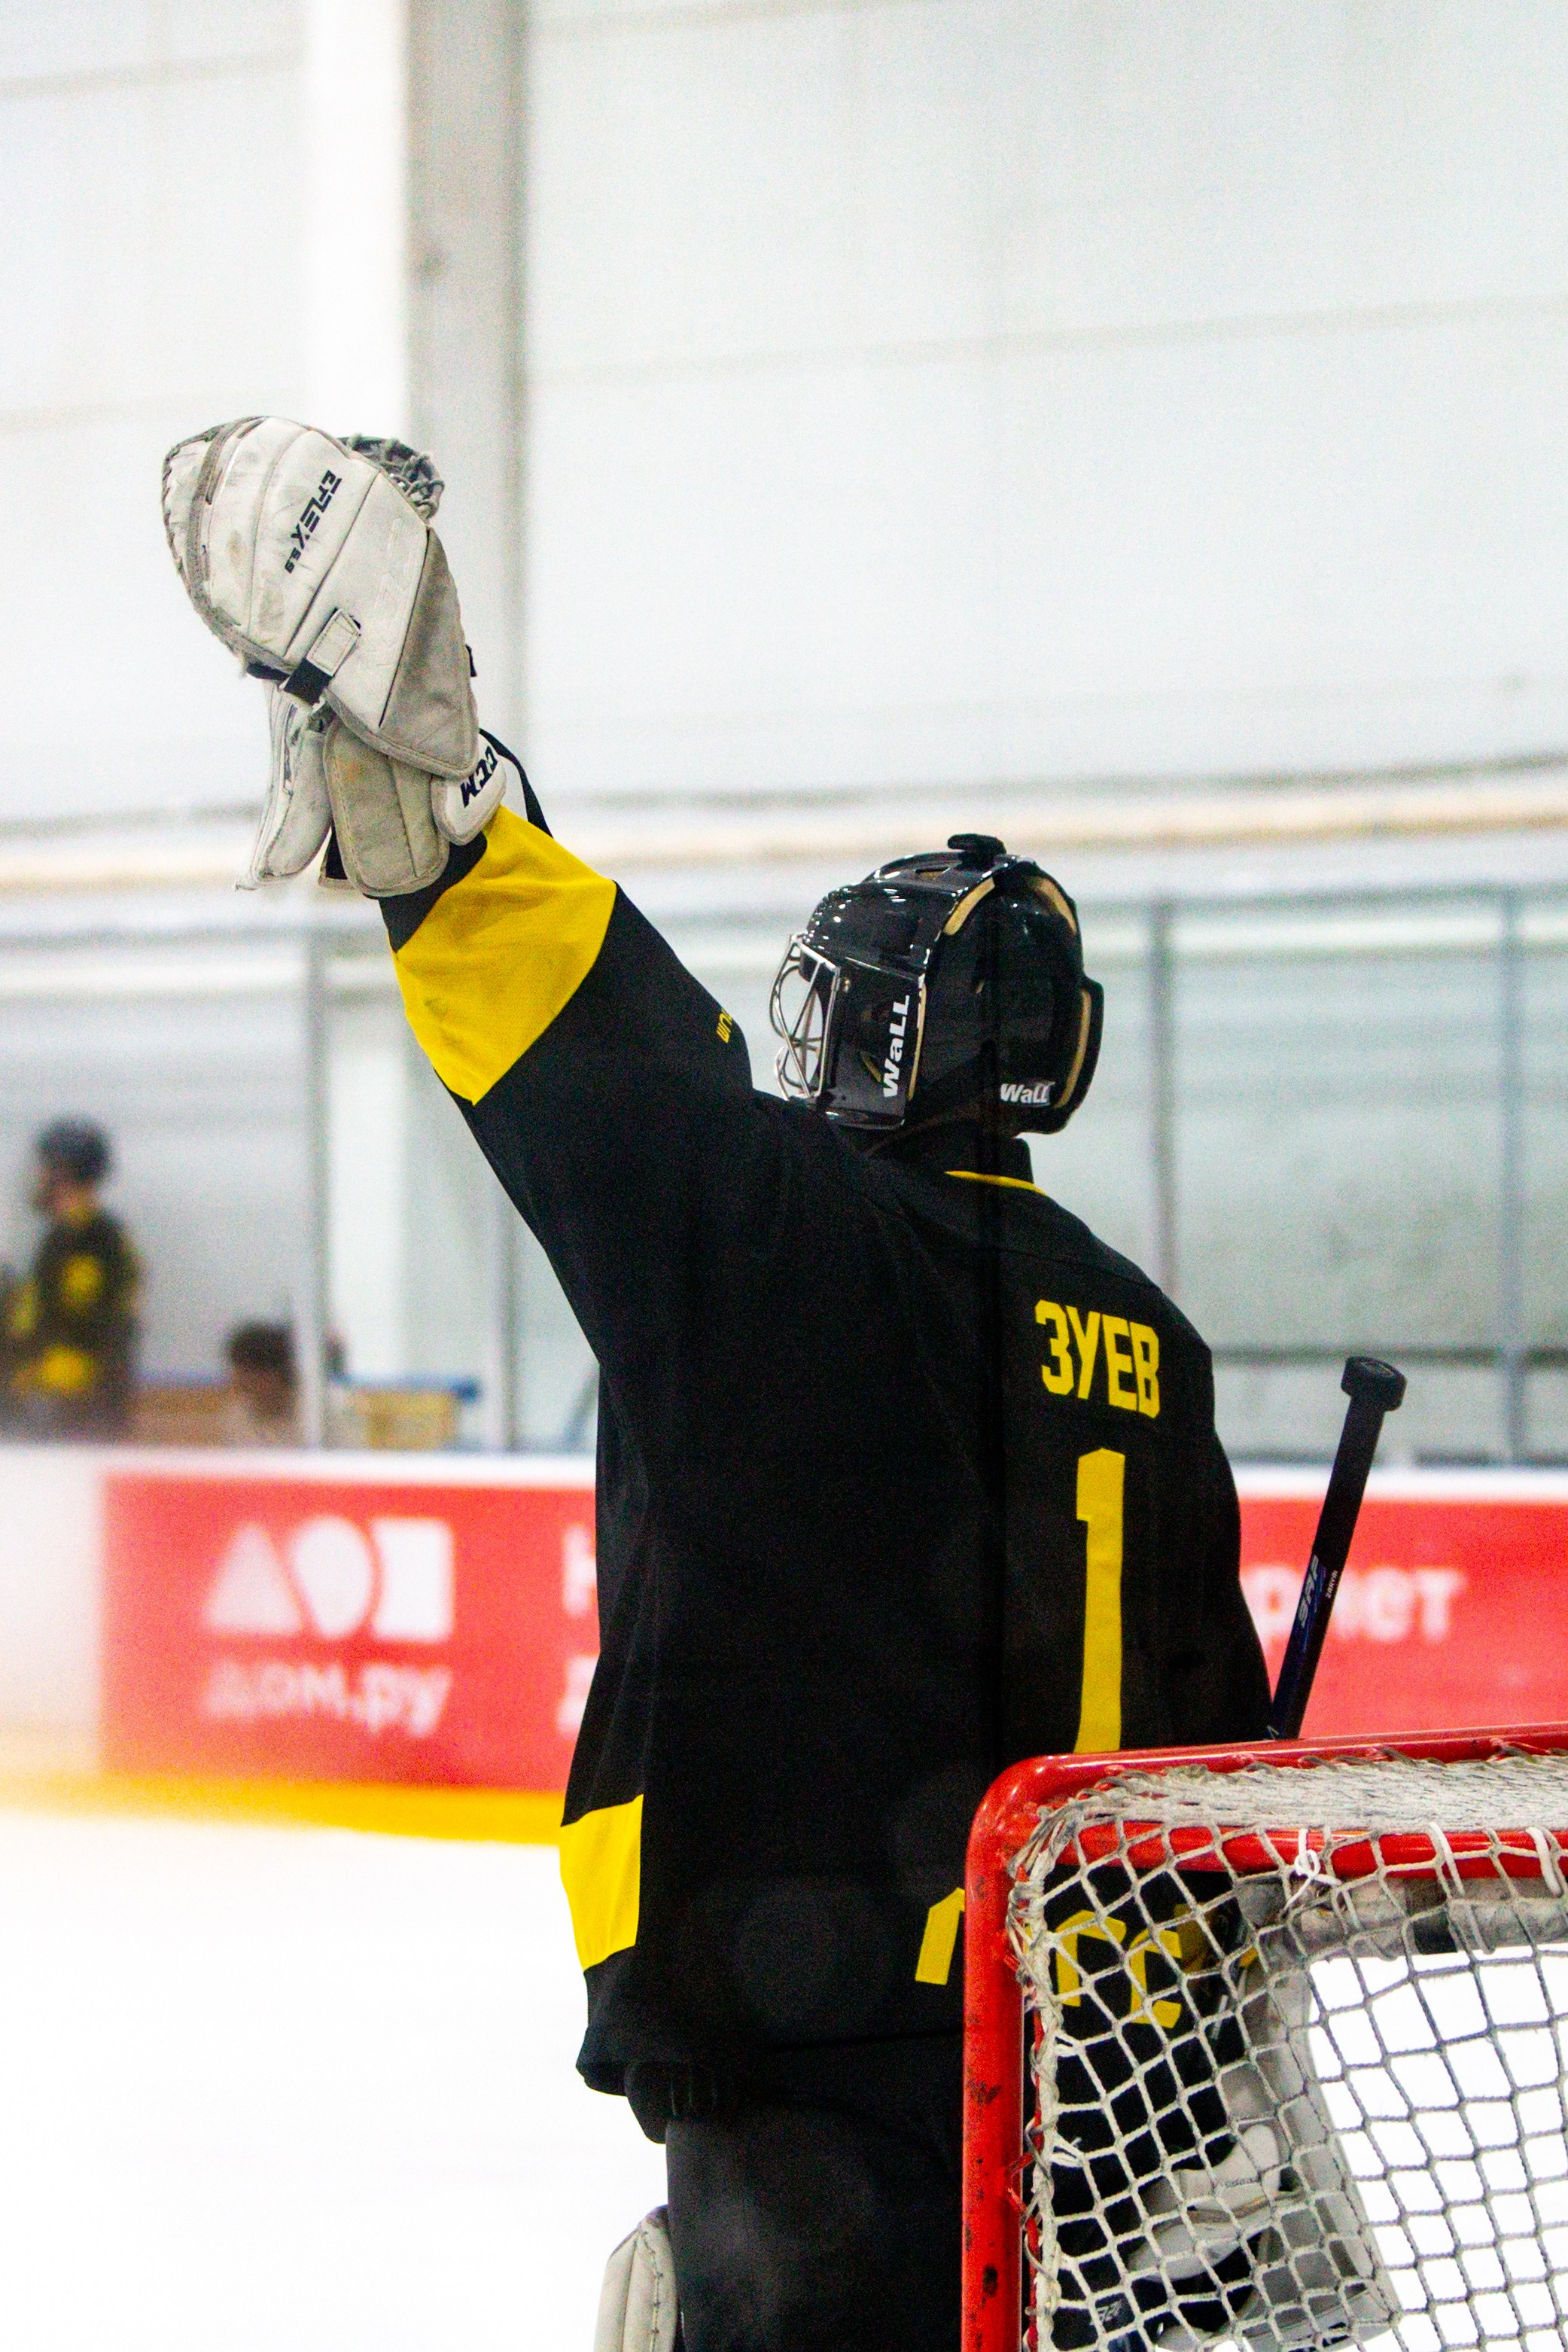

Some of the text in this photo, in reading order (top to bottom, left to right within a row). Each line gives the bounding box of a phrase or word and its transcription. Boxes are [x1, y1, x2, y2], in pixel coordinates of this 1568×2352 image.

[460, 745, 498, 809] CCM
[1035, 1299, 1160, 1418] ЗУЕВ
[1075, 1447, 1125, 1754] 1
